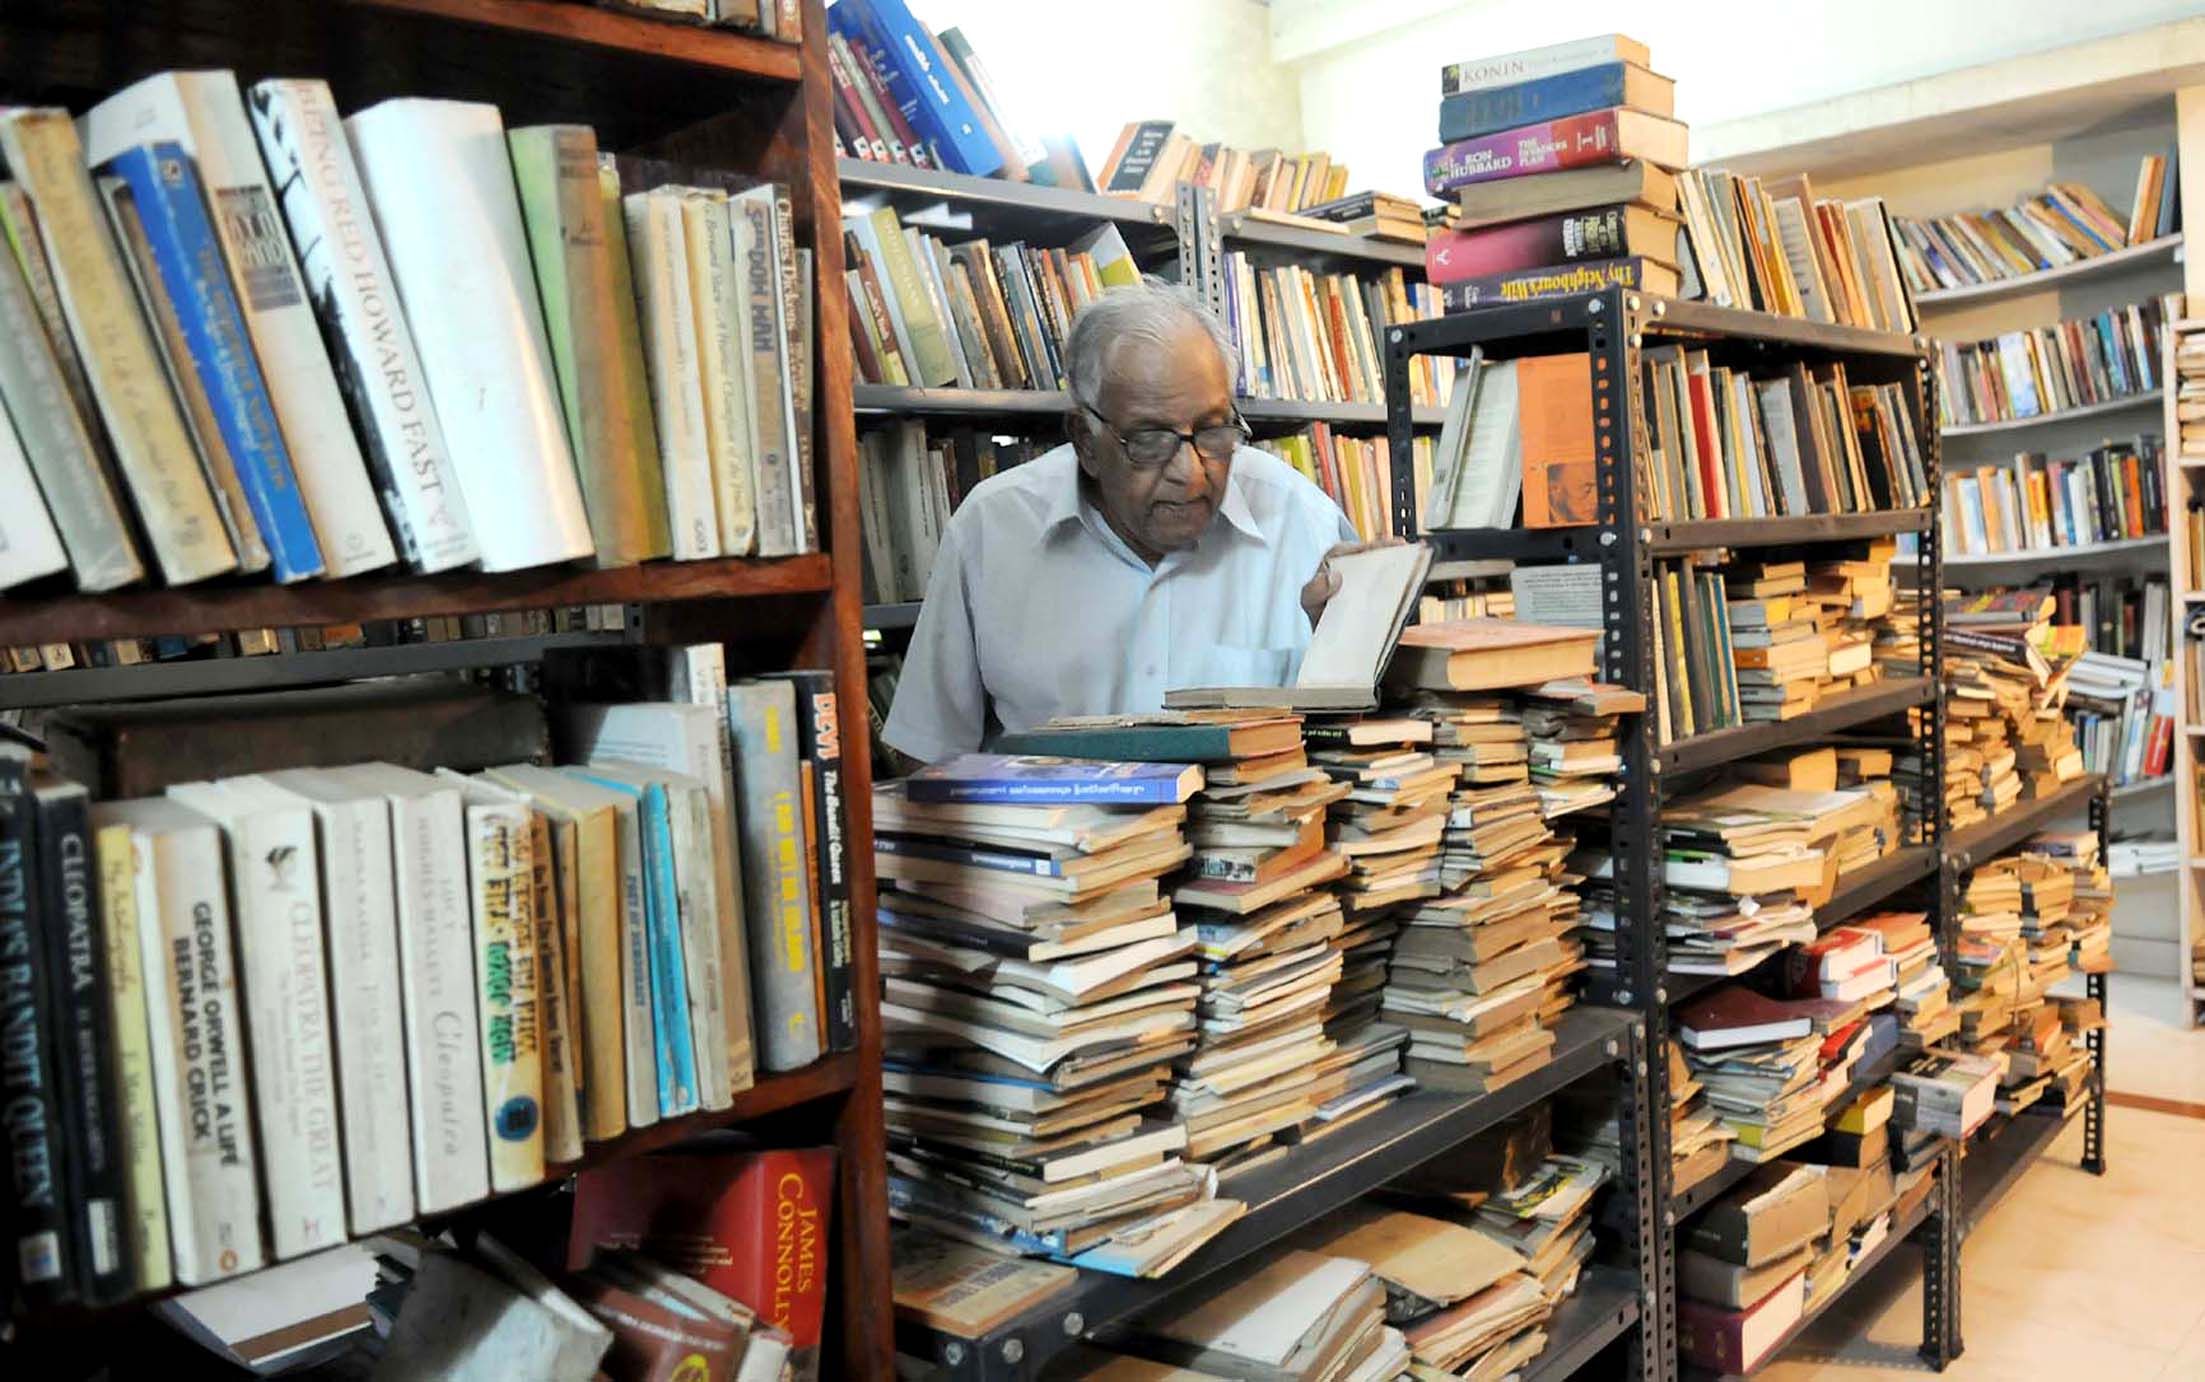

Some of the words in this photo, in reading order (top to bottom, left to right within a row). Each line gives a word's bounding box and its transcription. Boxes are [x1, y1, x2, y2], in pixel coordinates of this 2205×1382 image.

[1451, 155, 1512, 179] HUBBARD
[1465, 149, 1492, 163] RON
[775, 197, 795, 262] Charles
[291, 81, 345, 191] BEING
[327, 194, 368, 265] RED
[350, 267, 418, 415] HOWARD
[398, 416, 445, 498] FAST
[780, 264, 800, 330] Dickens
[750, 302, 774, 354] MAN
[813, 691, 839, 760] DEVI
[823, 769, 838, 792] The
[825, 793, 840, 840] Bandit
[827, 841, 843, 885] Queen
[57, 832, 94, 991] CLEOPATRA
[438, 876, 456, 931] LUCY
[192, 900, 219, 993] GEORGE
[285, 899, 324, 1043] CLEOPATRA
[0, 963, 43, 1089] BANDIT
[172, 936, 203, 1061] BERNARD
[202, 1000, 230, 1096] ORWELL
[299, 1050, 329, 1097] THE
[427, 1008, 472, 1157] Cleopatra
[186, 1065, 212, 1140] CRICK
[213, 1102, 231, 1119] A
[6, 1099, 54, 1207] QUEEN
[215, 1122, 240, 1168] LIFE
[305, 1104, 339, 1193] GREAT
[775, 1172, 804, 1332] CONNOLLY
[797, 1207, 817, 1294] JAMES
